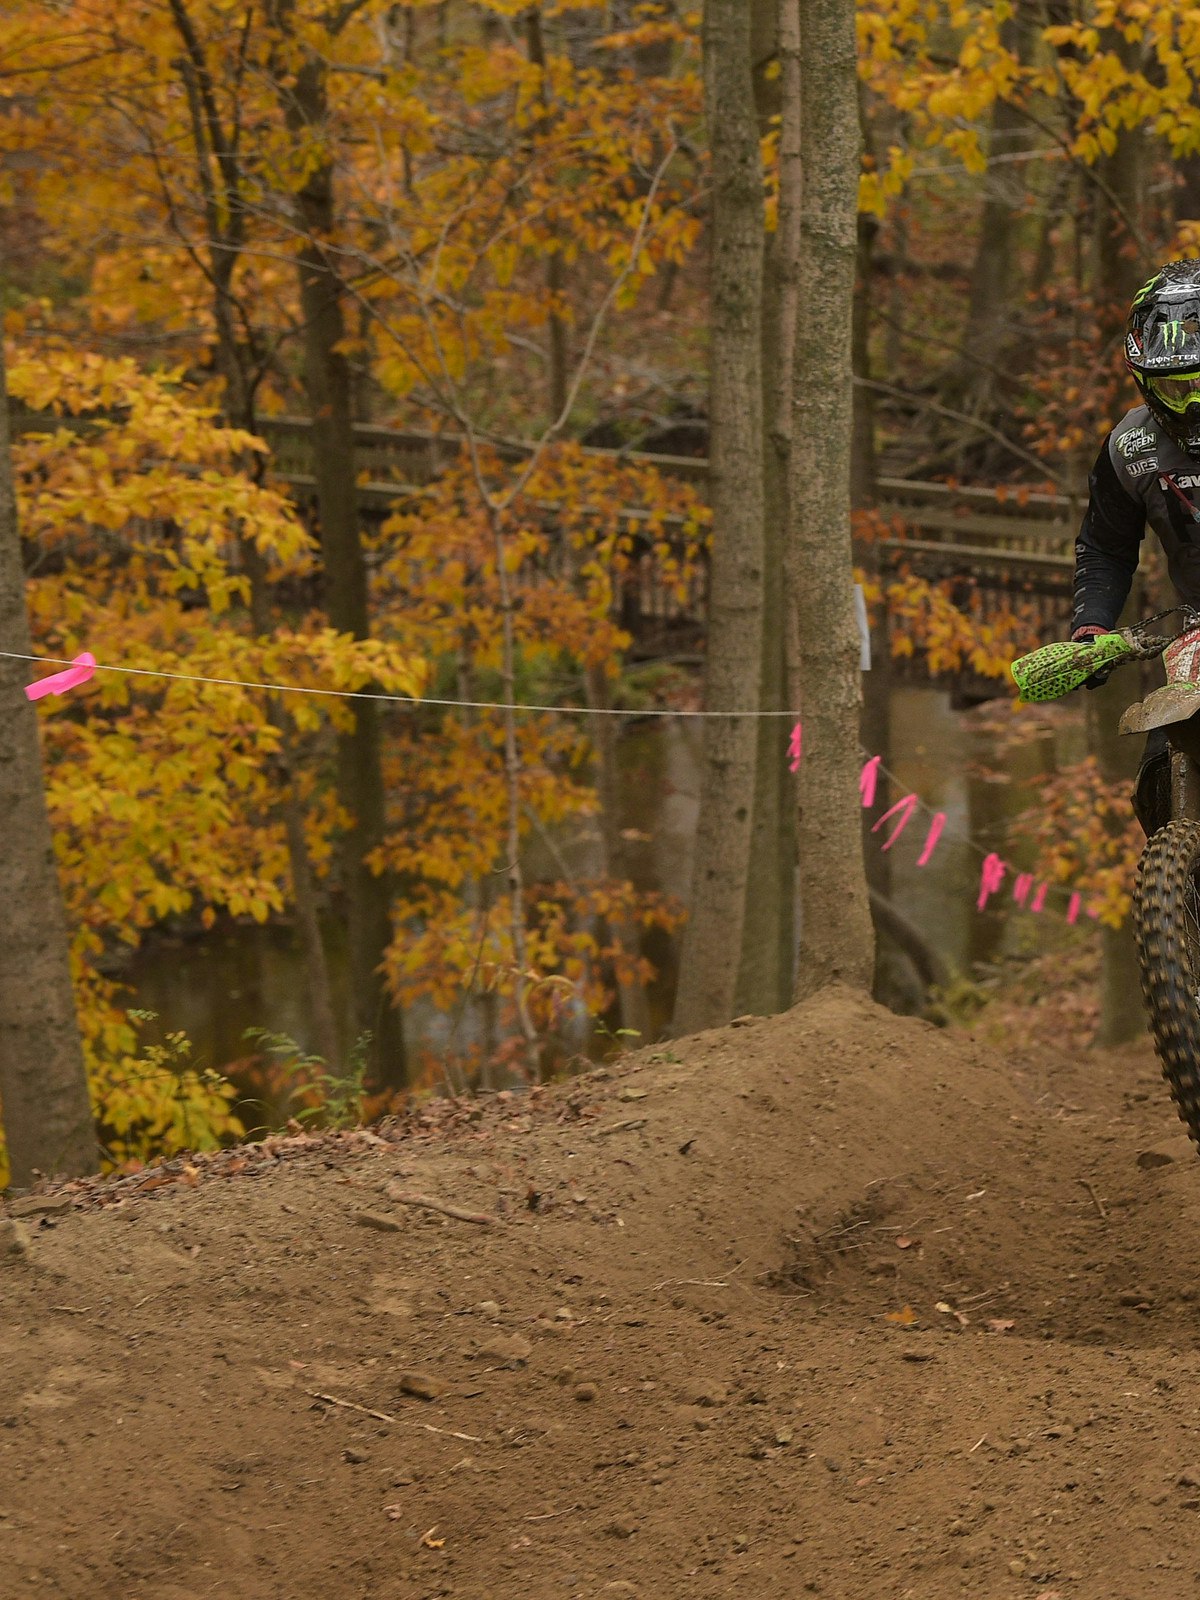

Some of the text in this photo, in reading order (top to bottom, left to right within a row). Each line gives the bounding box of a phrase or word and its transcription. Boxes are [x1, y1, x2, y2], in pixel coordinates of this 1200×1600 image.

[1115, 427, 1144, 449] TEAM
[1124, 434, 1155, 458] GREEN
[1126, 457, 1158, 477] WPS
